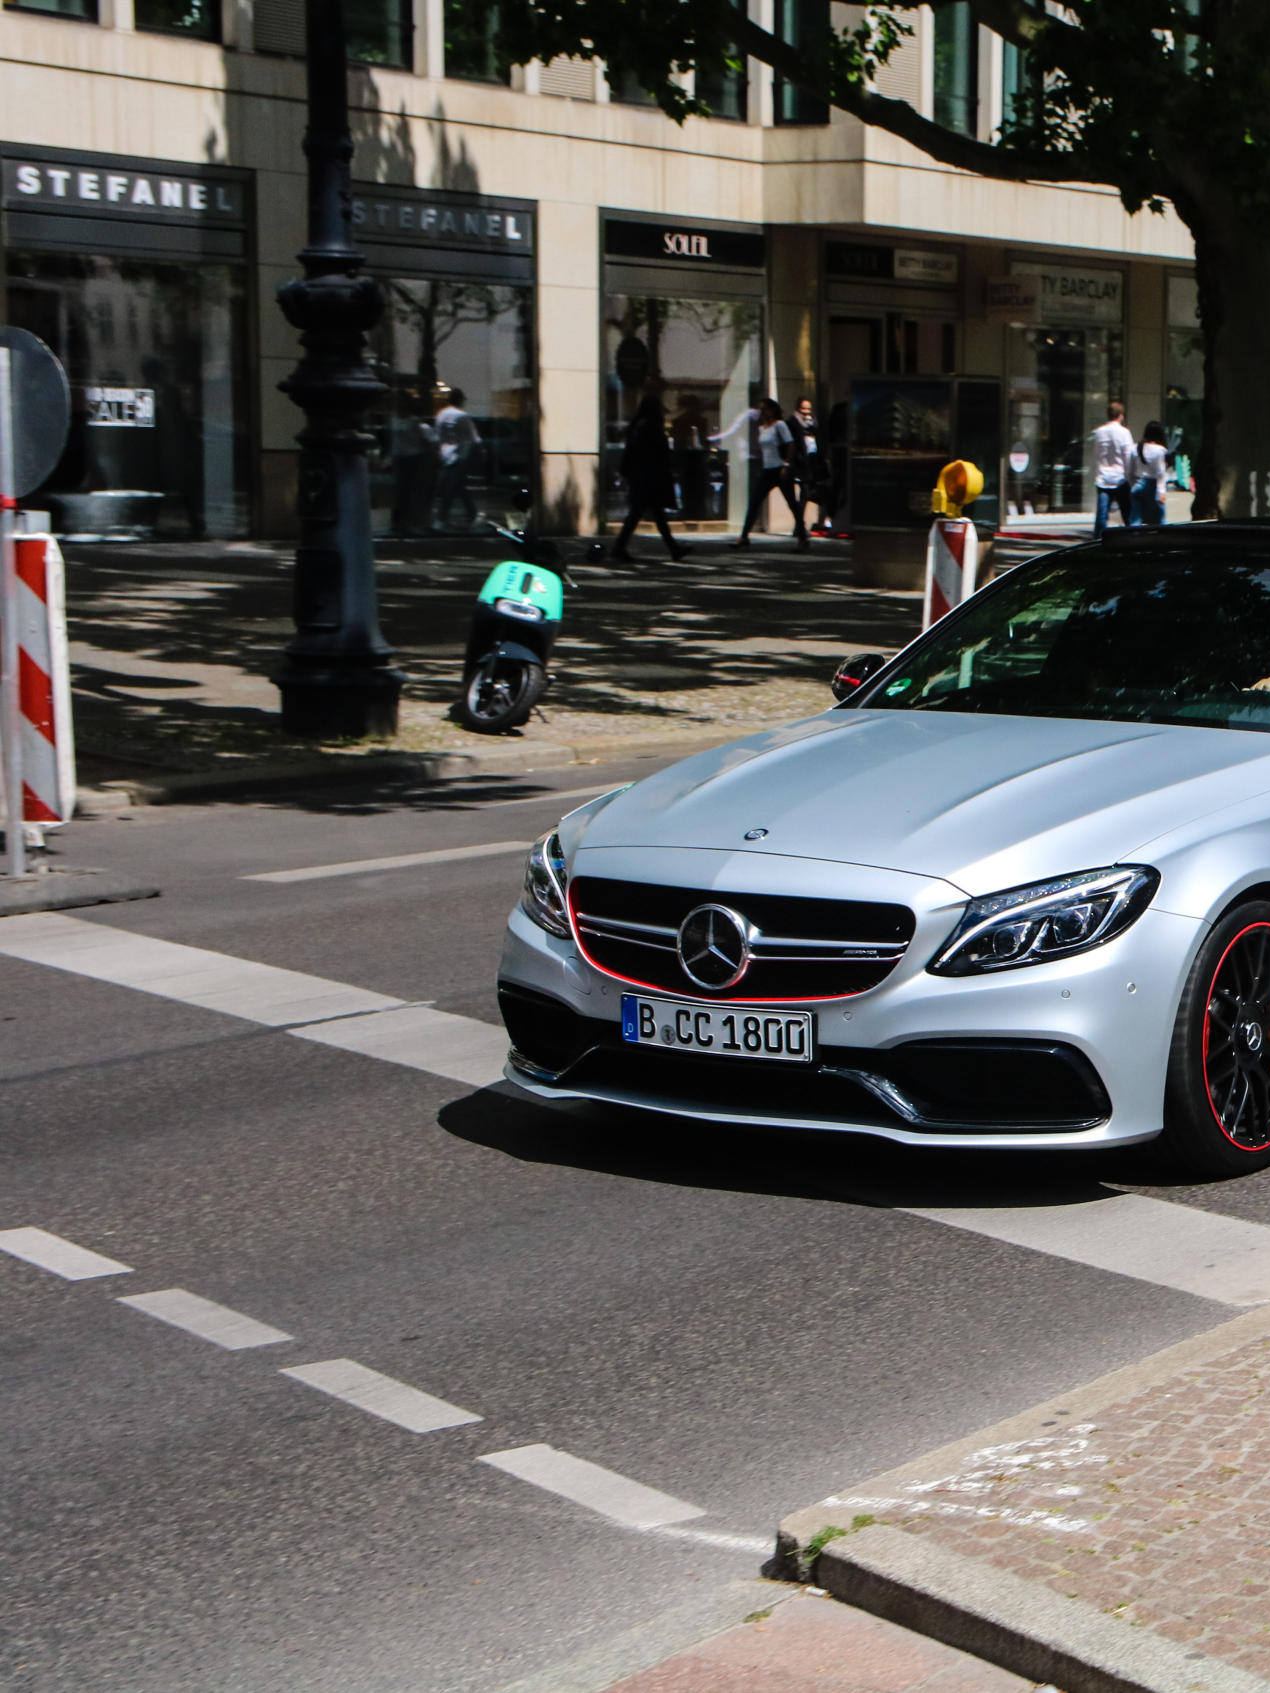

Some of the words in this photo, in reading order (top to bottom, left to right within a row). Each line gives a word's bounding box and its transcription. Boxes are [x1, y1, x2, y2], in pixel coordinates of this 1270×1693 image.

[16, 165, 234, 212] STEFANEL
[351, 201, 522, 240] STEFANEL
[1060, 275, 1120, 300] BARCLAY
[639, 1002, 656, 1038] B
[675, 1009, 714, 1047] CC
[722, 1014, 805, 1055] 1800
